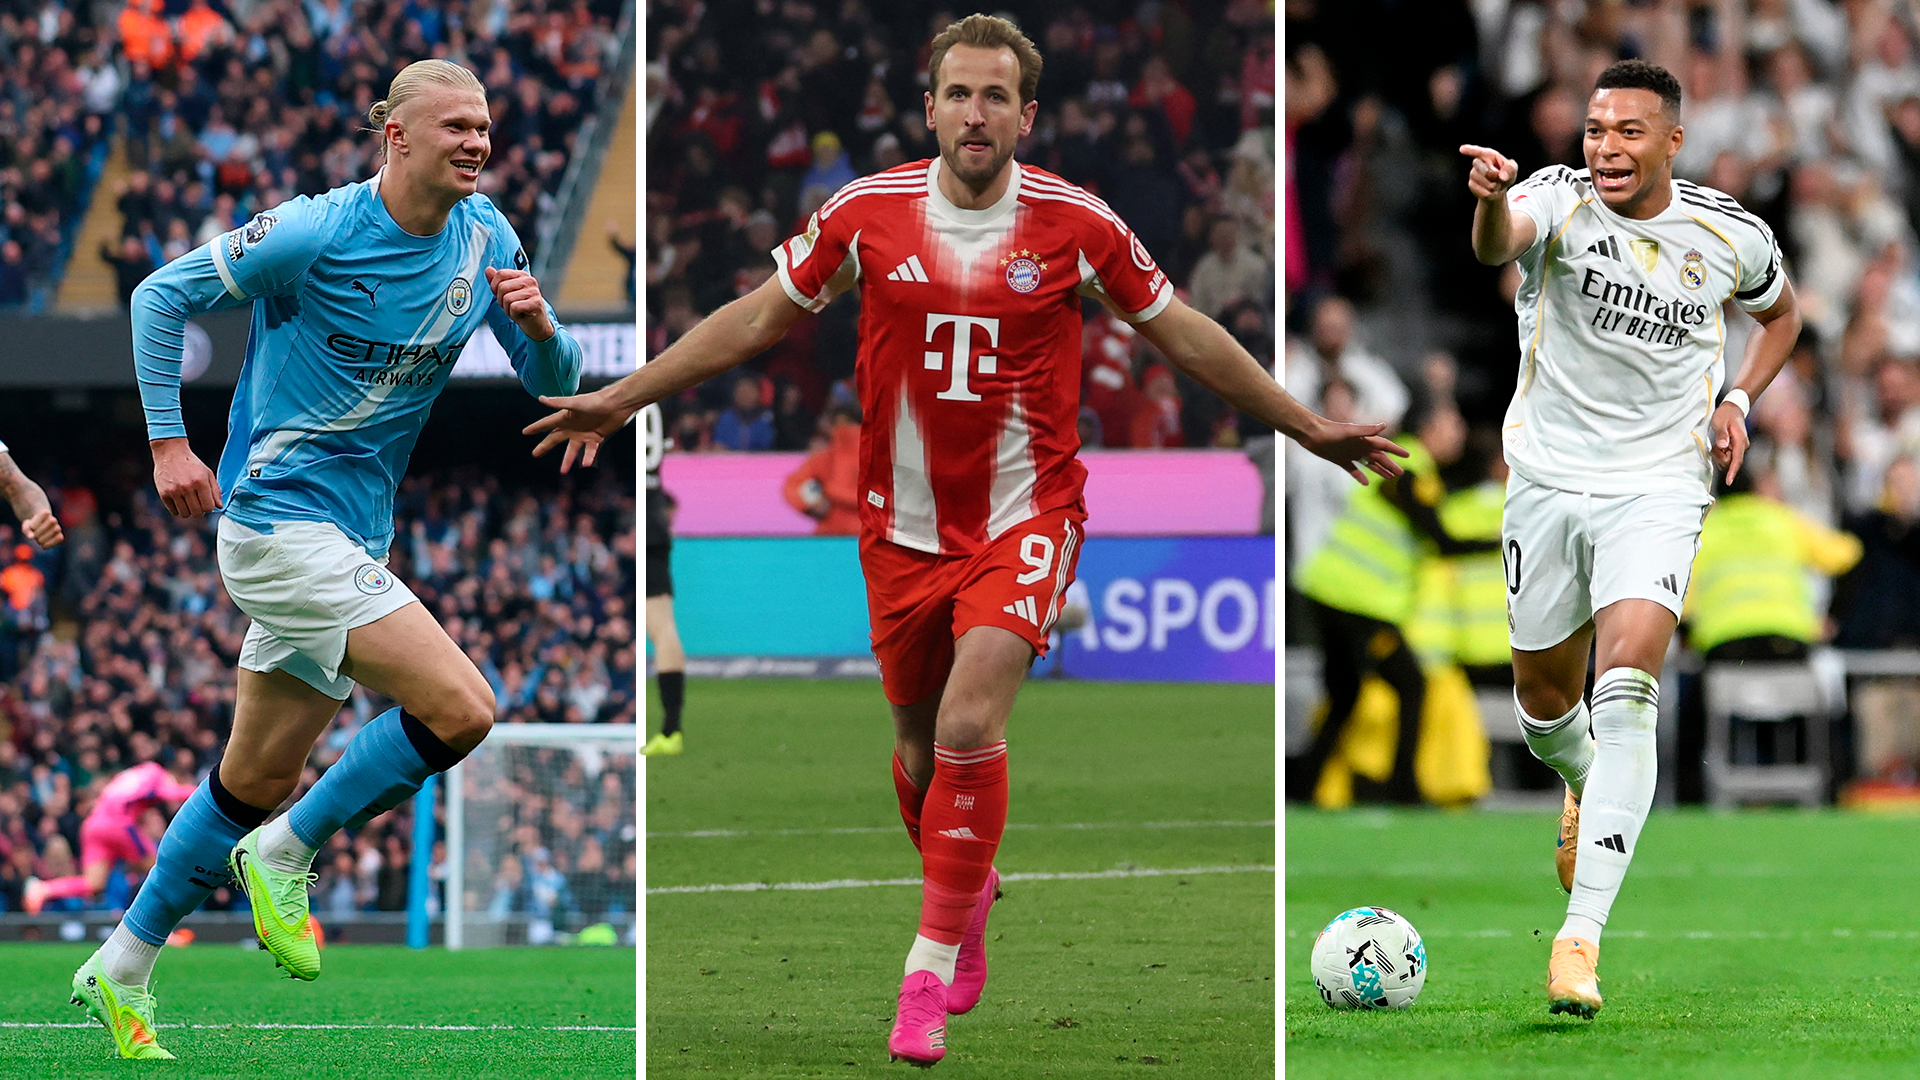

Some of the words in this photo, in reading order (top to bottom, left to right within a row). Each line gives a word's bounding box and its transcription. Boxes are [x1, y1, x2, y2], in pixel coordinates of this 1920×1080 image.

[1015, 260, 1038, 275] BAYERN
[1581, 267, 1707, 325] Emirates
[1591, 306, 1625, 332] FLY
[1625, 316, 1689, 346] BETTER
[353, 368, 435, 386] AIRWAYS
[1016, 533, 1055, 585] 9
[1048, 577, 1276, 652] ASPO
